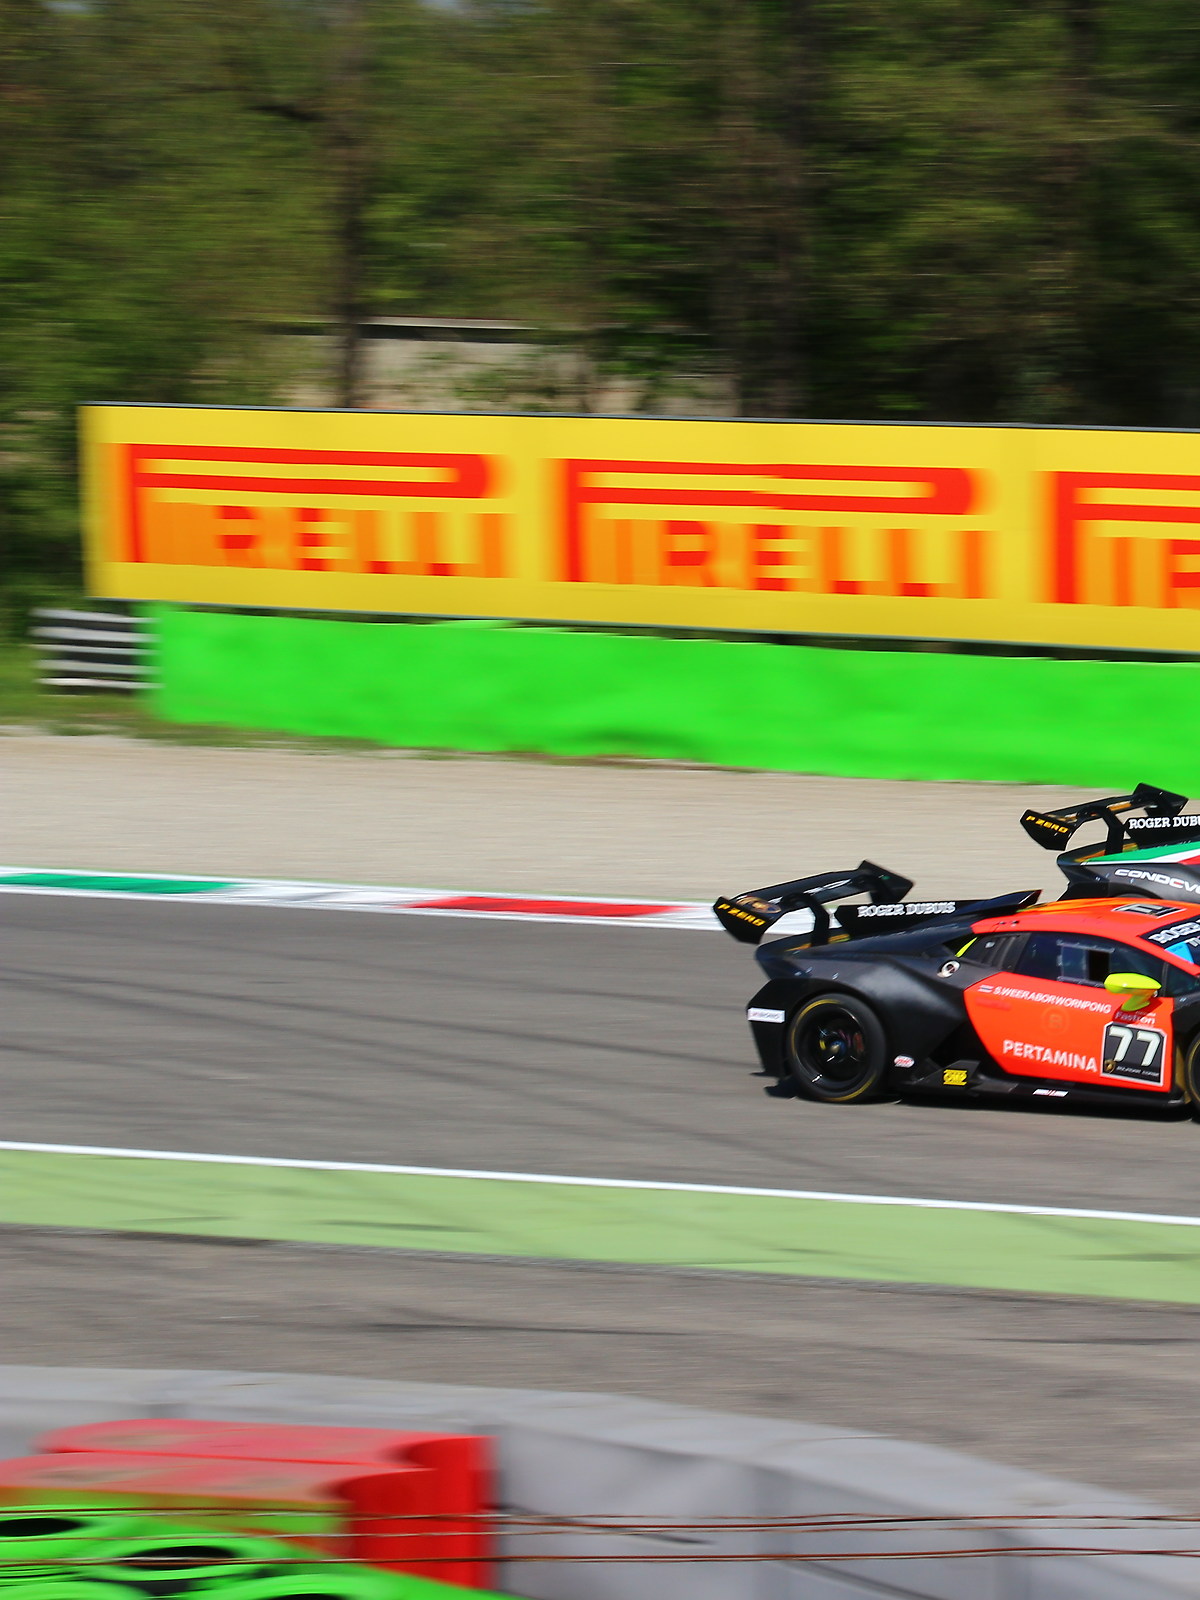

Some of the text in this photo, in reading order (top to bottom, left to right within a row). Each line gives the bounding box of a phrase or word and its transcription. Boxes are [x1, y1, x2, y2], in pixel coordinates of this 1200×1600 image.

[120, 443, 512, 578] PIRELLI
[556, 457, 996, 600] PIRELLI
[1128, 817, 1171, 830] ROGER
[857, 901, 956, 918] ROGER DUBUIS
[1002, 1039, 1098, 1073] PERTAMINA
[1108, 1025, 1161, 1067] 77
